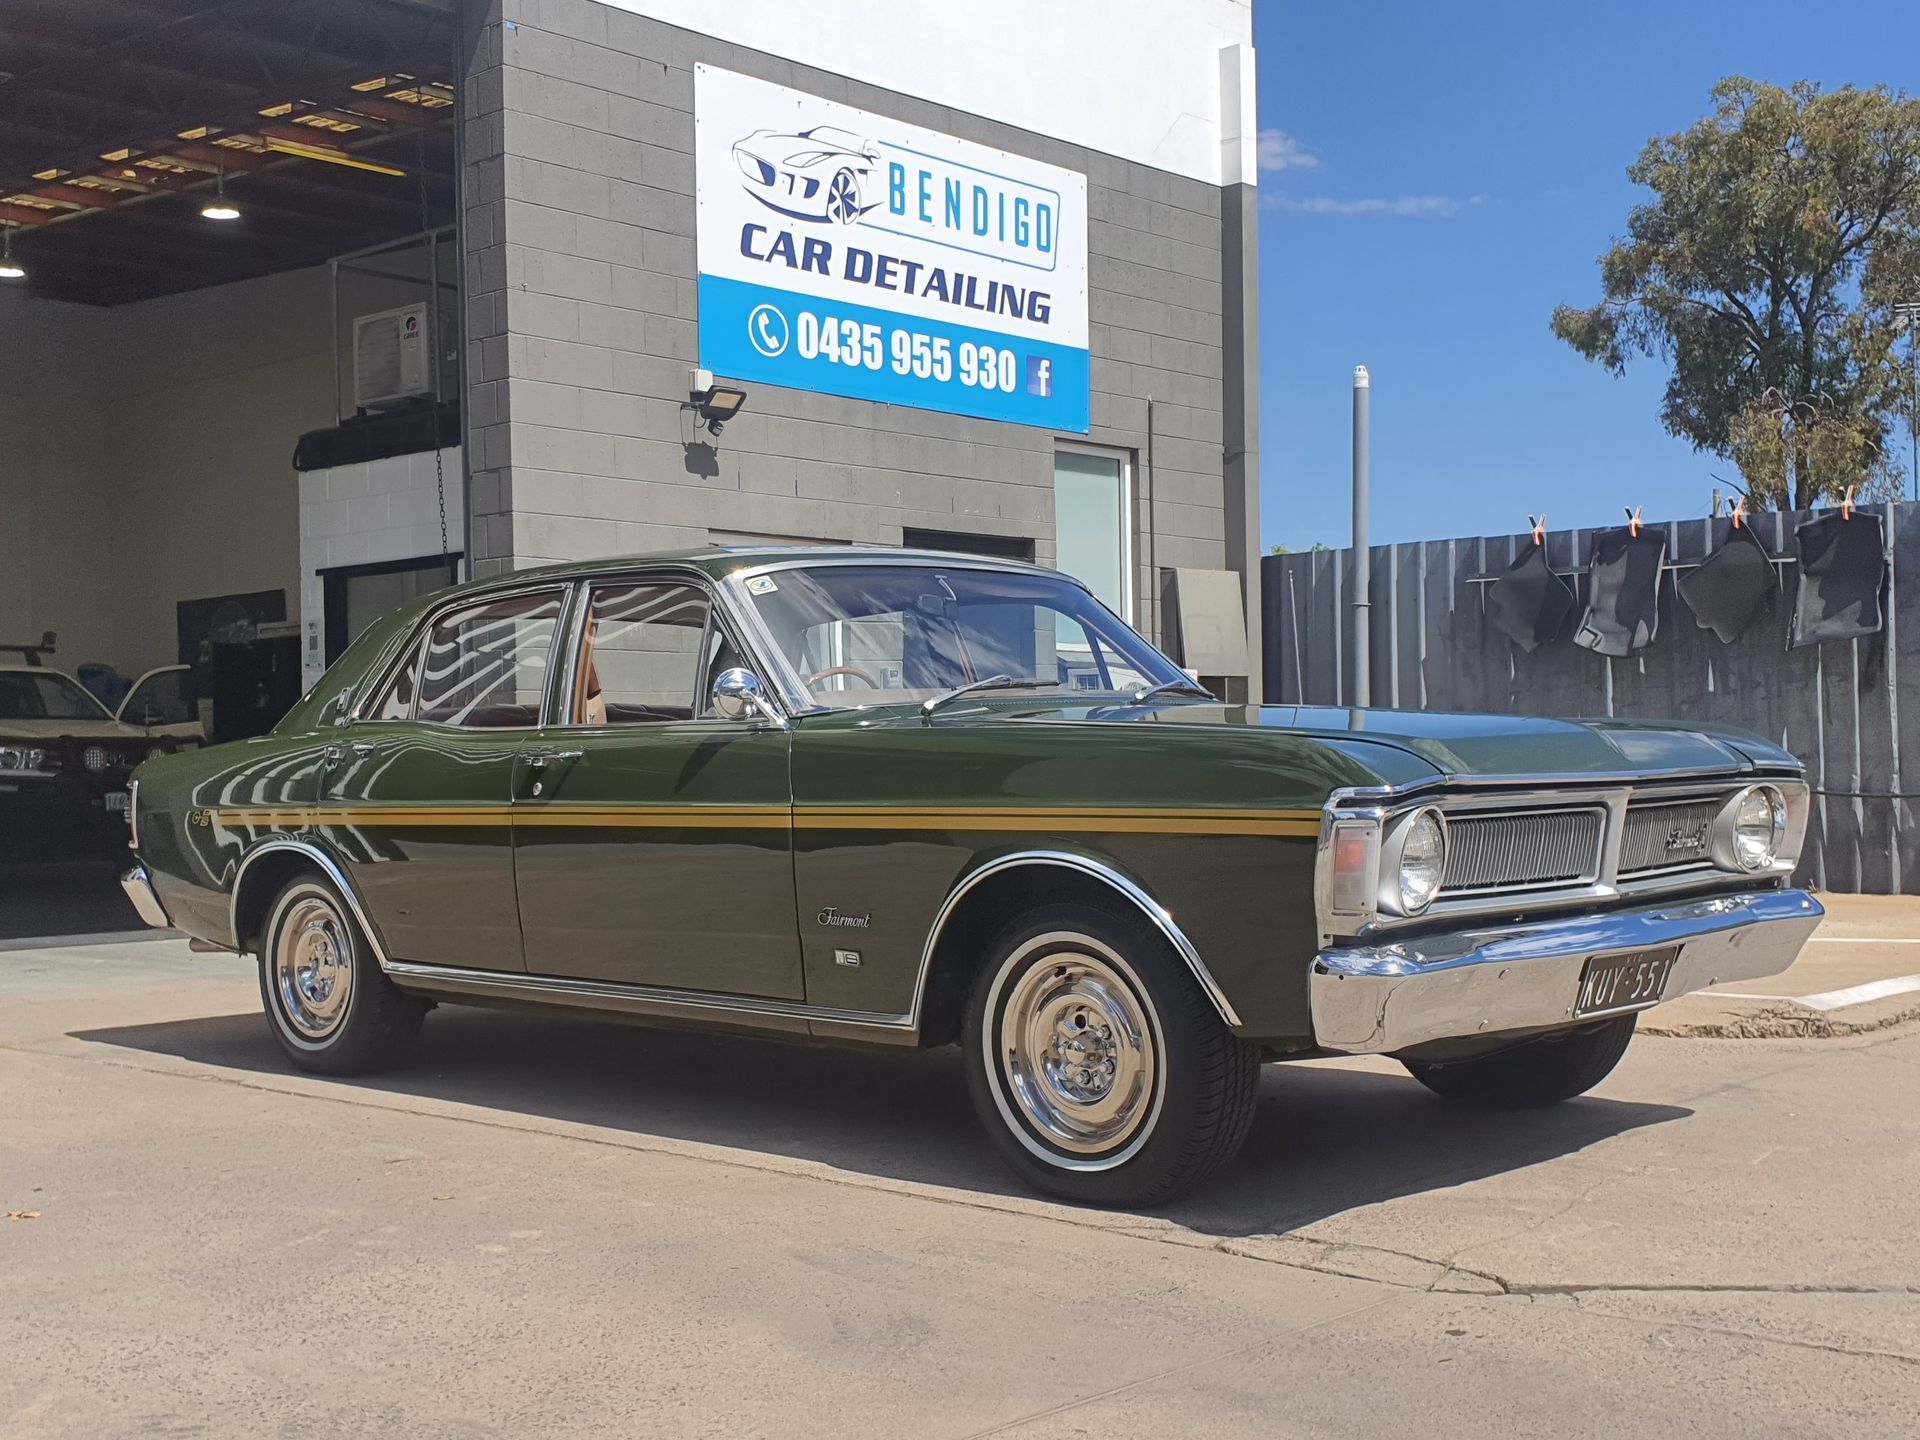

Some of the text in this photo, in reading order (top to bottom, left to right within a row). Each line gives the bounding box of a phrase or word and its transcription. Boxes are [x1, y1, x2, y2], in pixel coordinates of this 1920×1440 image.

[888, 161, 1051, 253] BENDIGO
[740, 222, 1051, 324] CAR DETAILING
[797, 311, 1016, 393] 0435 955 930
[817, 906, 871, 928] Fairmont
[1581, 959, 1669, 1008] KUY 551
